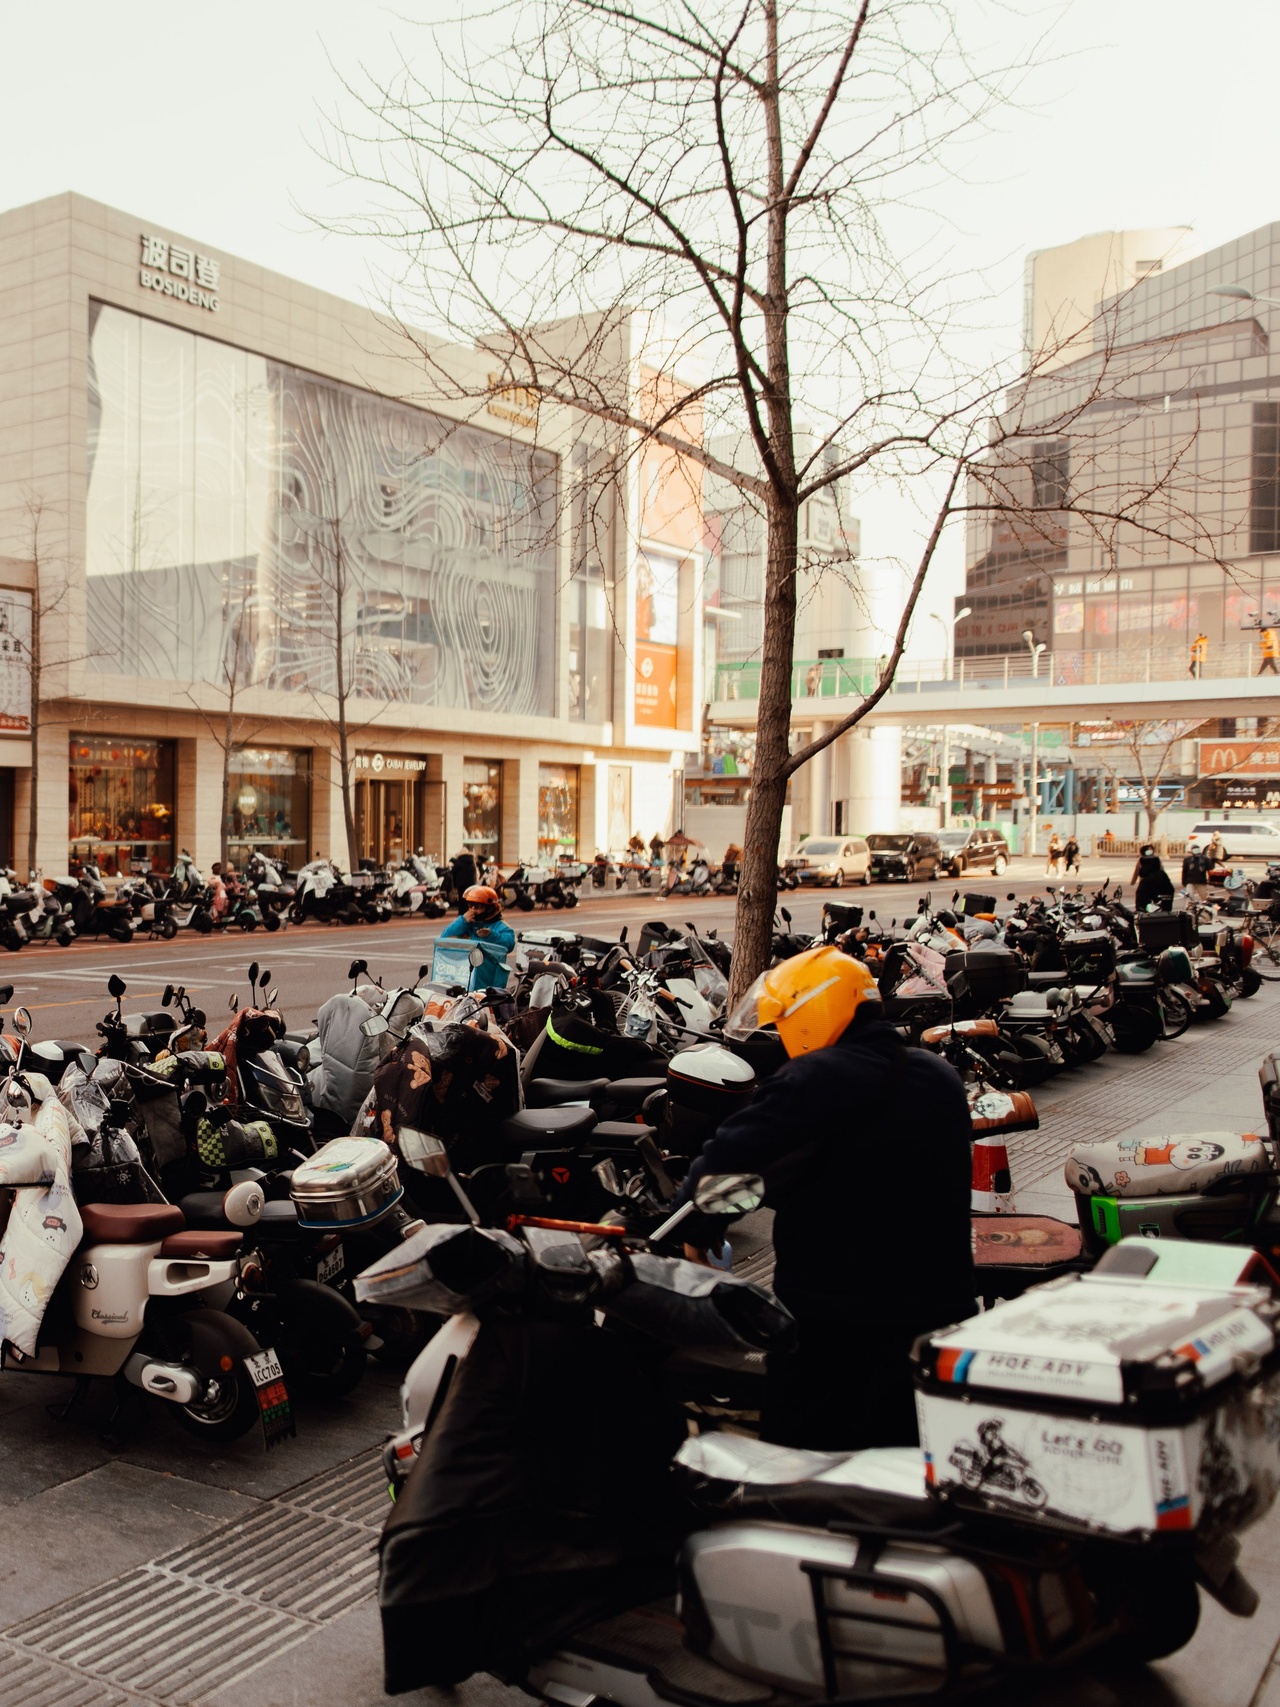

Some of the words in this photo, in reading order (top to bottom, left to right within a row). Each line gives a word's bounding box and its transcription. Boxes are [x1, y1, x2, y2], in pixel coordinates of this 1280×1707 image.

[140, 234, 220, 291] 波司登
[140, 269, 220, 312] BOSIDENG
[91, 1309, 129, 1323] Classical
[253, 1363, 280, 1384] ACC705
